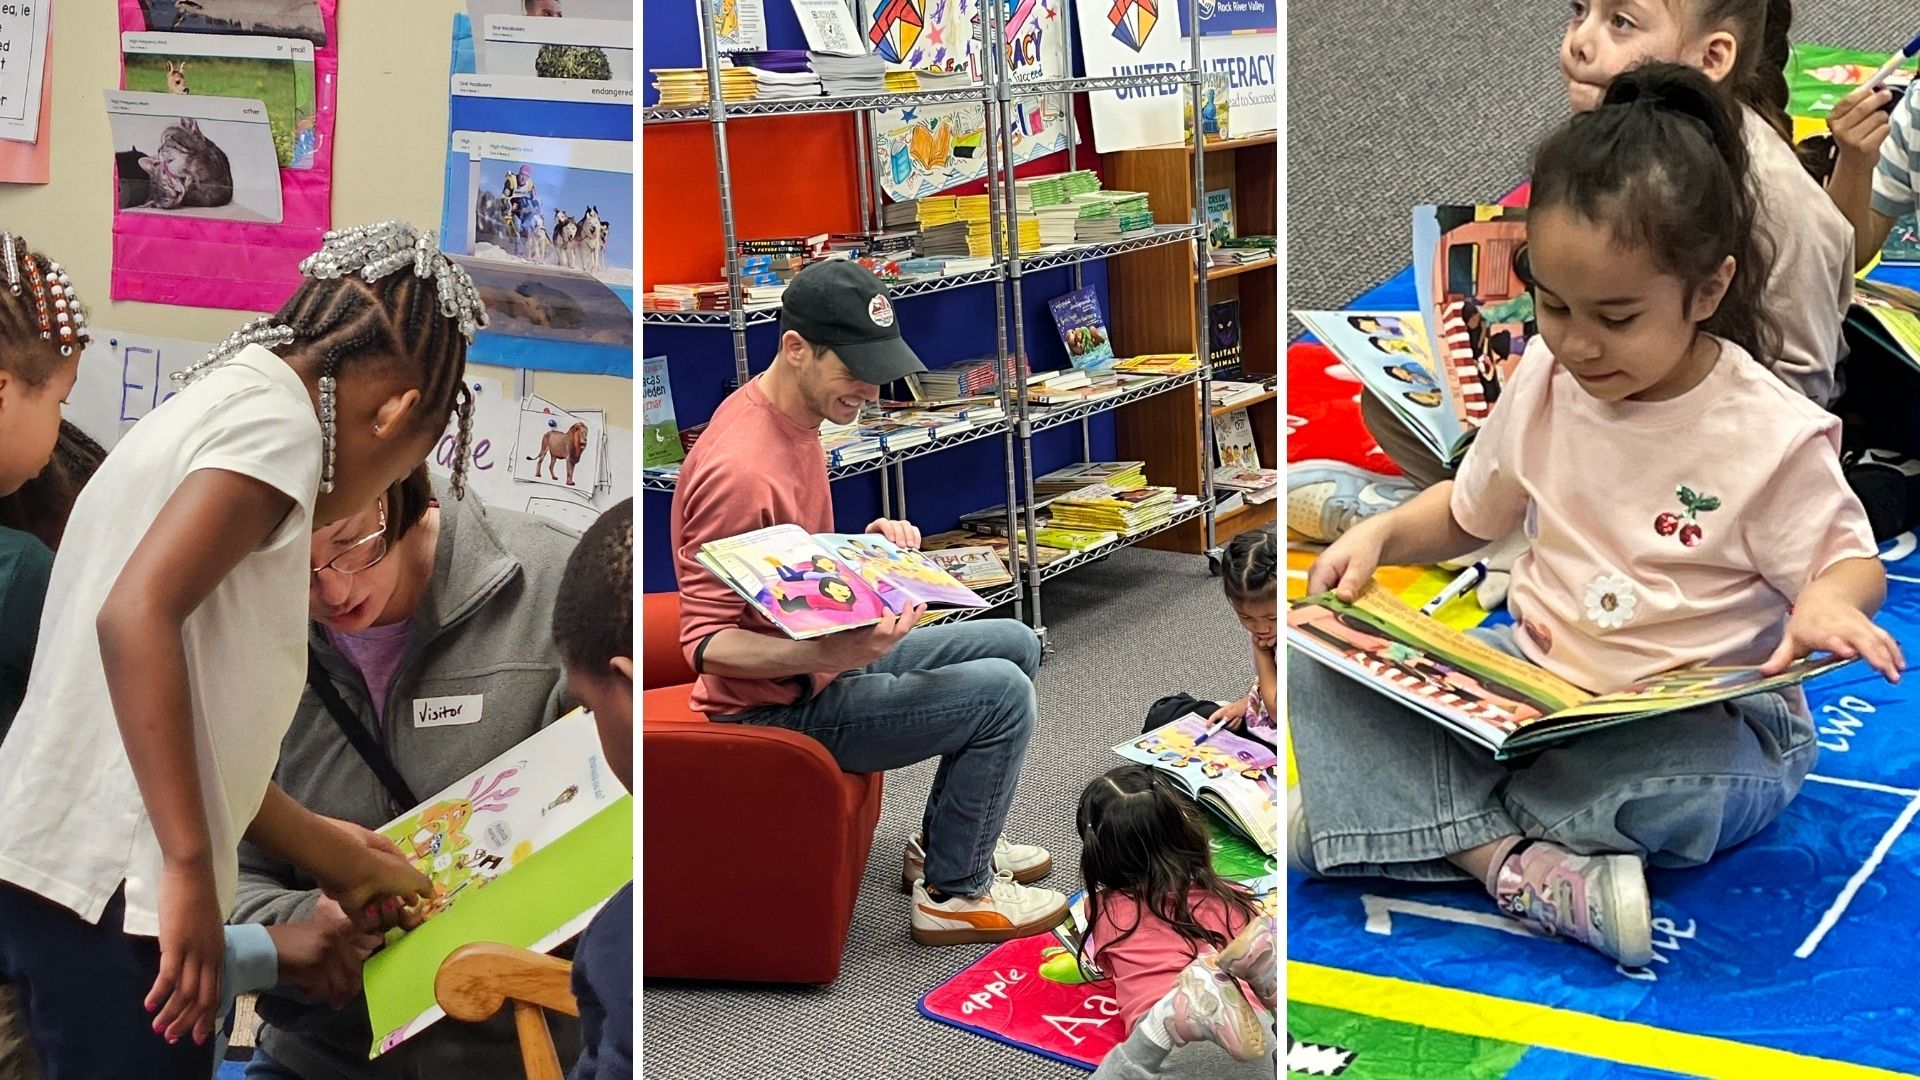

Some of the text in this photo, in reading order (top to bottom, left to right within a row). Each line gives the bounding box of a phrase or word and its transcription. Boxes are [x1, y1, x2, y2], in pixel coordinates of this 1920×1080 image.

[1217, 2, 1265, 13] Rock River Valley
[591, 88, 633, 97] endangered
[1248, 89, 1277, 106] Succeed
[1210, 346, 1240, 359] OLITARY
[419, 702, 464, 723] Visitor
[1816, 695, 1877, 752] two
[961, 966, 1028, 1015] apple
